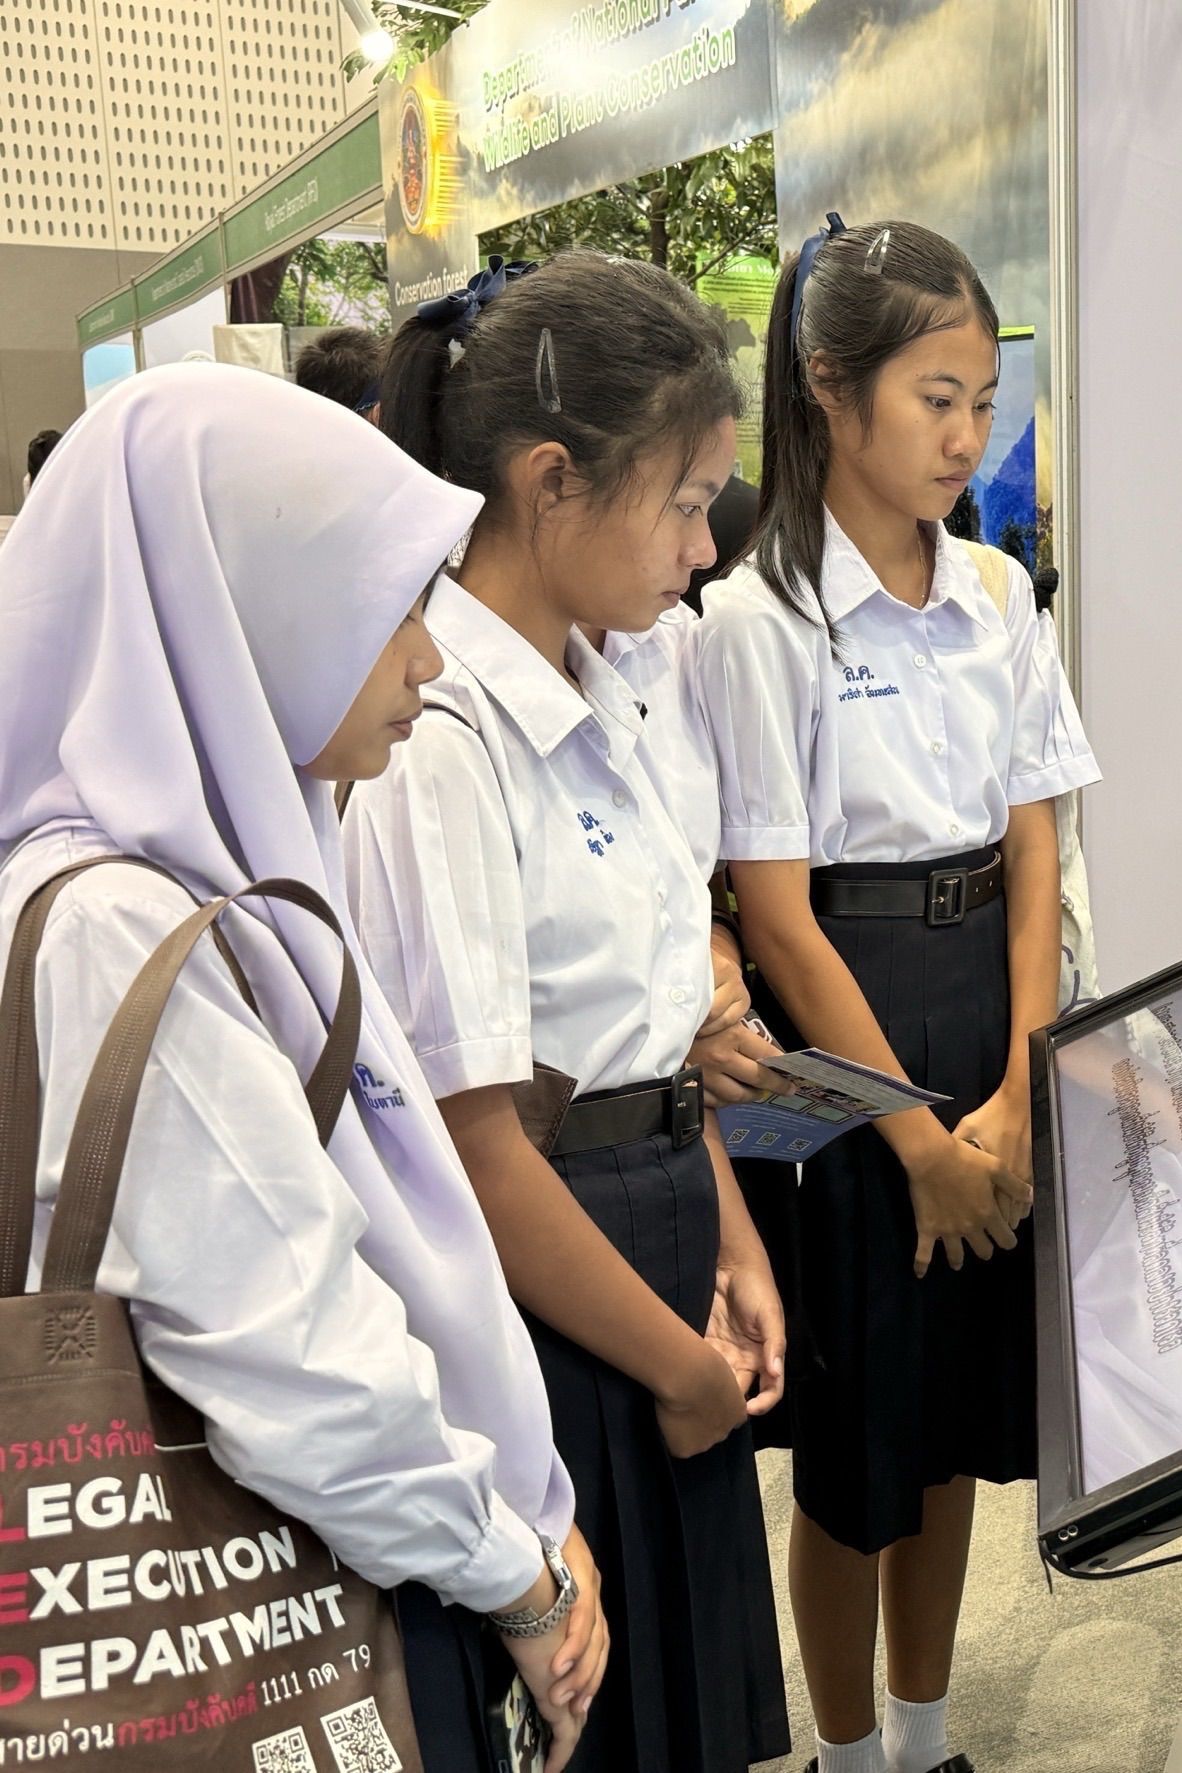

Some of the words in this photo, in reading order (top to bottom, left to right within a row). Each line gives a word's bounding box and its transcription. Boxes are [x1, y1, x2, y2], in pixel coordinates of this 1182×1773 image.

[531, 95, 559, 150] and
[606, 25, 737, 117] Conservation
[395, 271, 442, 306] Conservation
[443, 264, 468, 296] forest
[0, 1526, 297, 1625] EXECUTION
[0, 1583, 346, 1707] DEPARTMENT
[261, 1671, 303, 1706] 1111
[306, 1661, 340, 1691] กด
[343, 1644, 372, 1673] 79
